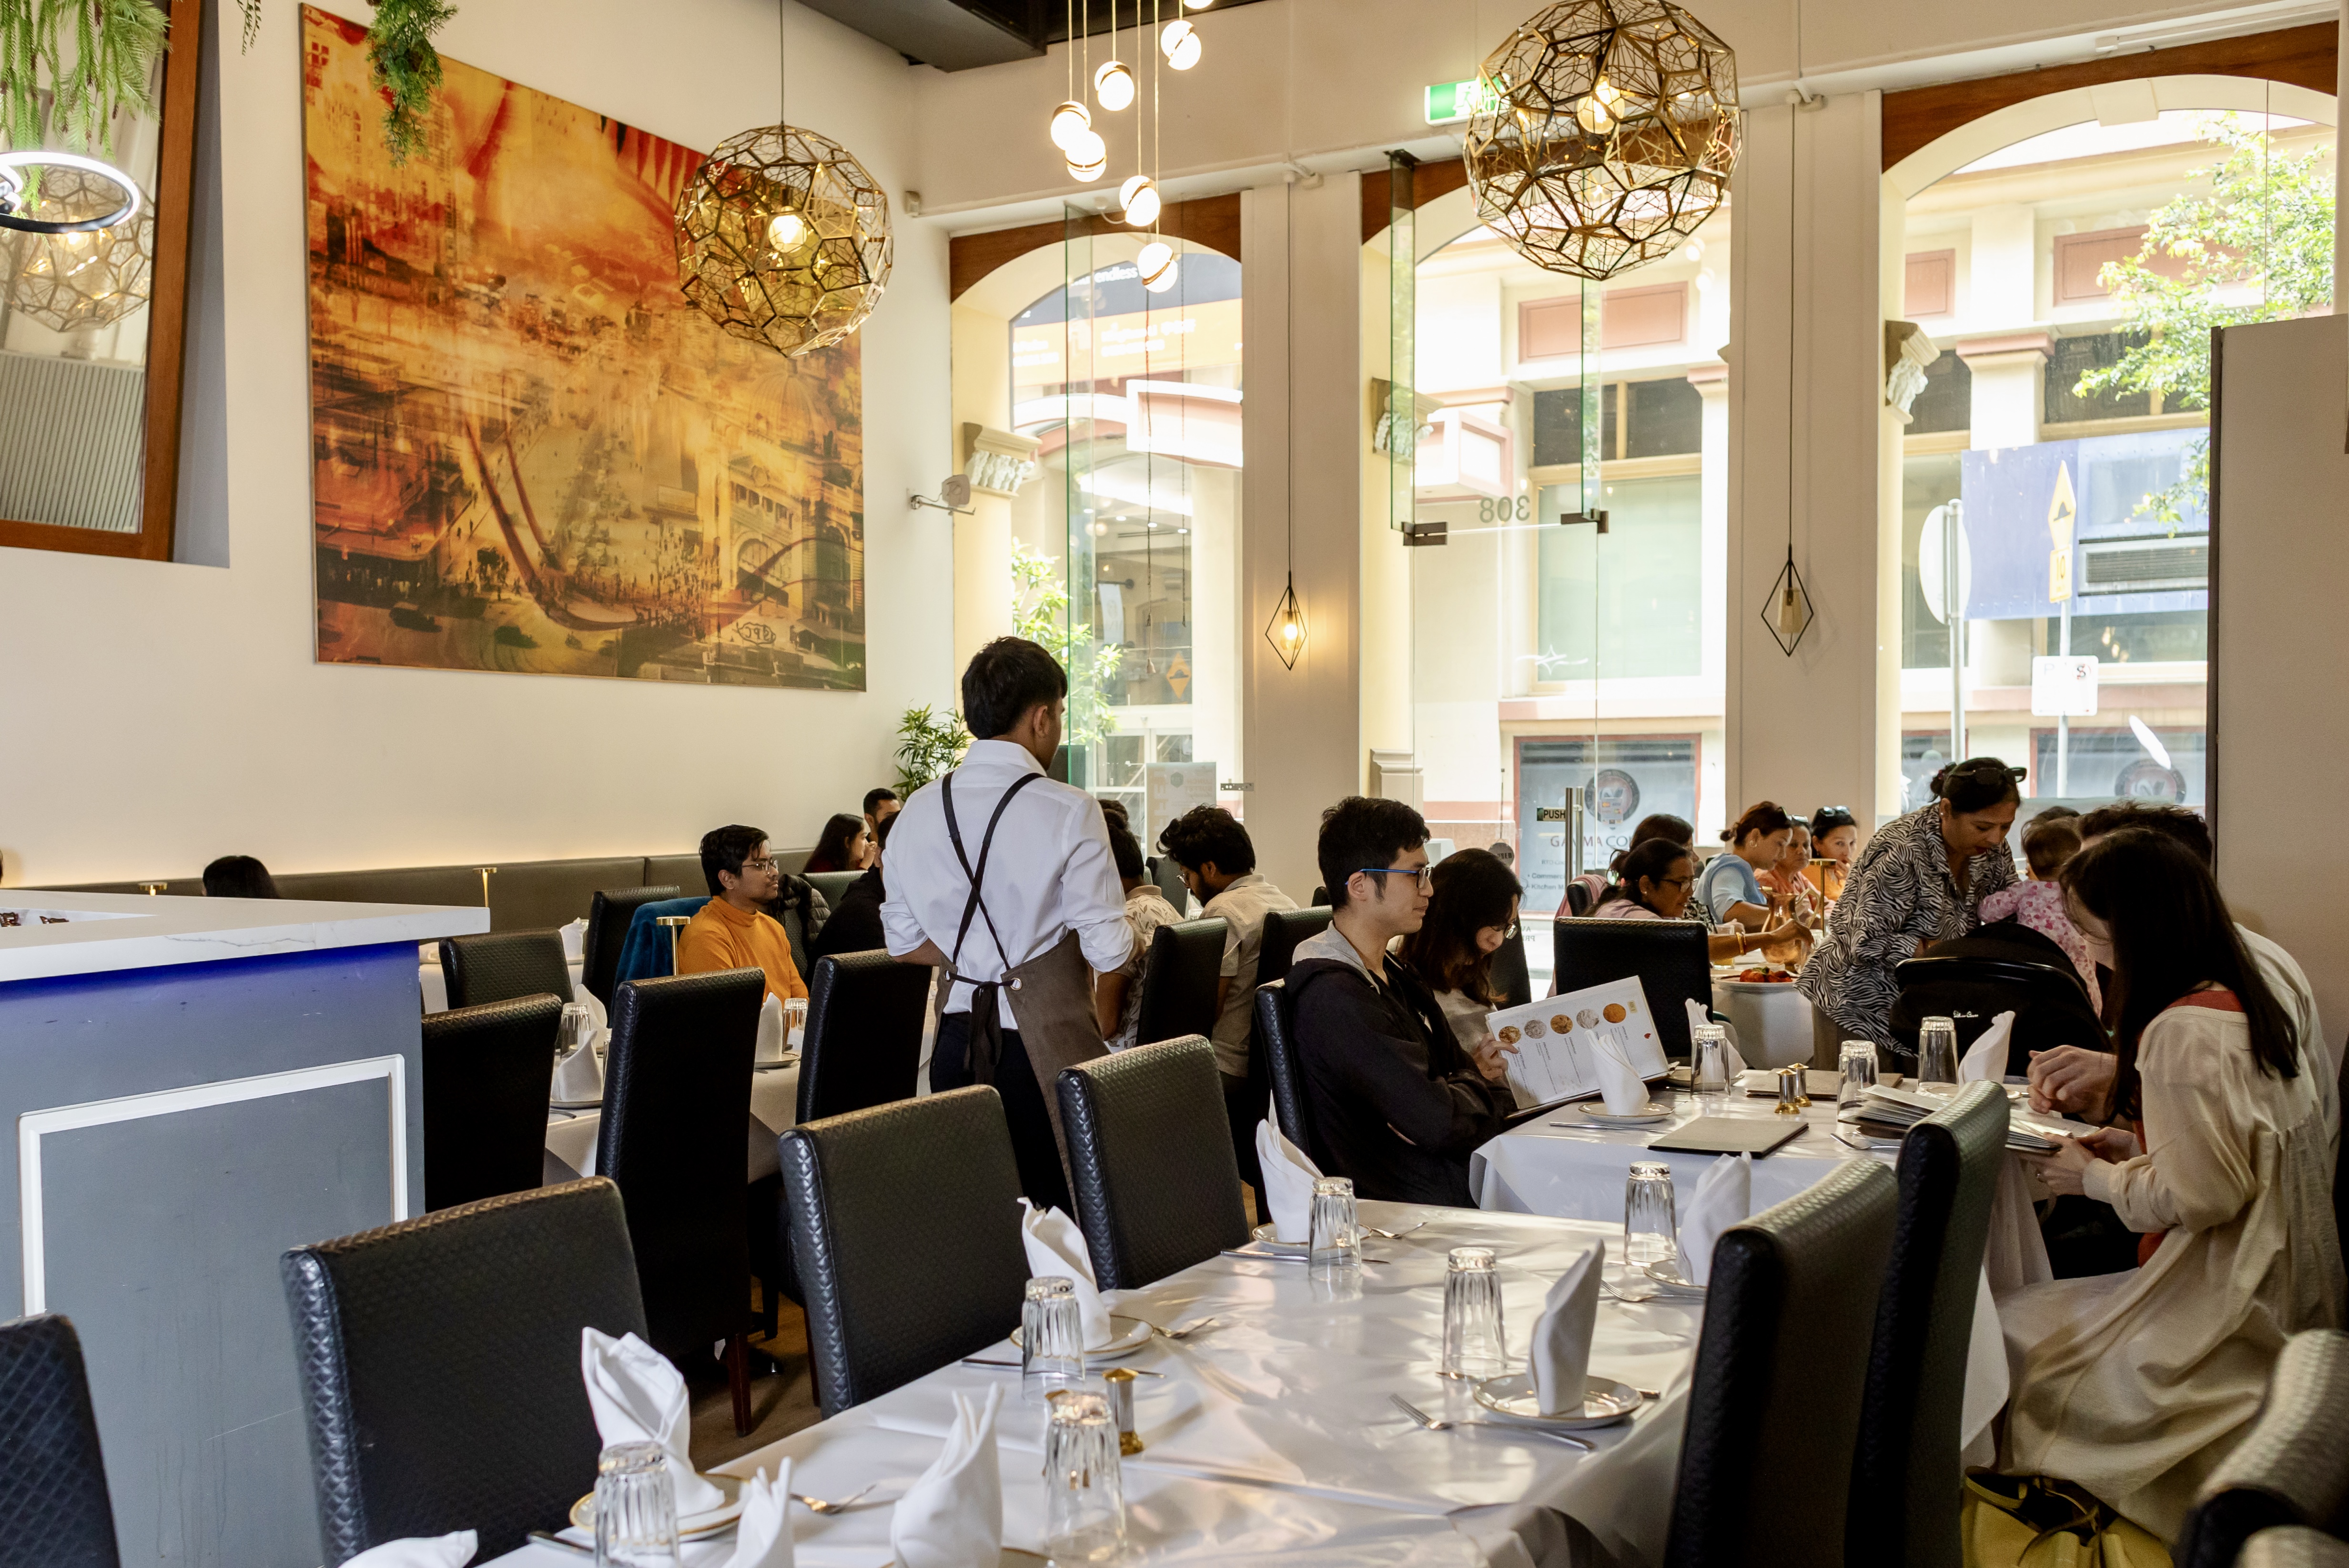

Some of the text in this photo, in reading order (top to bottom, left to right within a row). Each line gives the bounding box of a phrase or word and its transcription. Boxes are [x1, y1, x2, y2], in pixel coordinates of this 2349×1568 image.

[1094, 266, 1138, 283] endless
[2056, 555, 2066, 580] 10
[2044, 663, 2055, 675] P
[1544, 809, 1566, 819] PUSH
